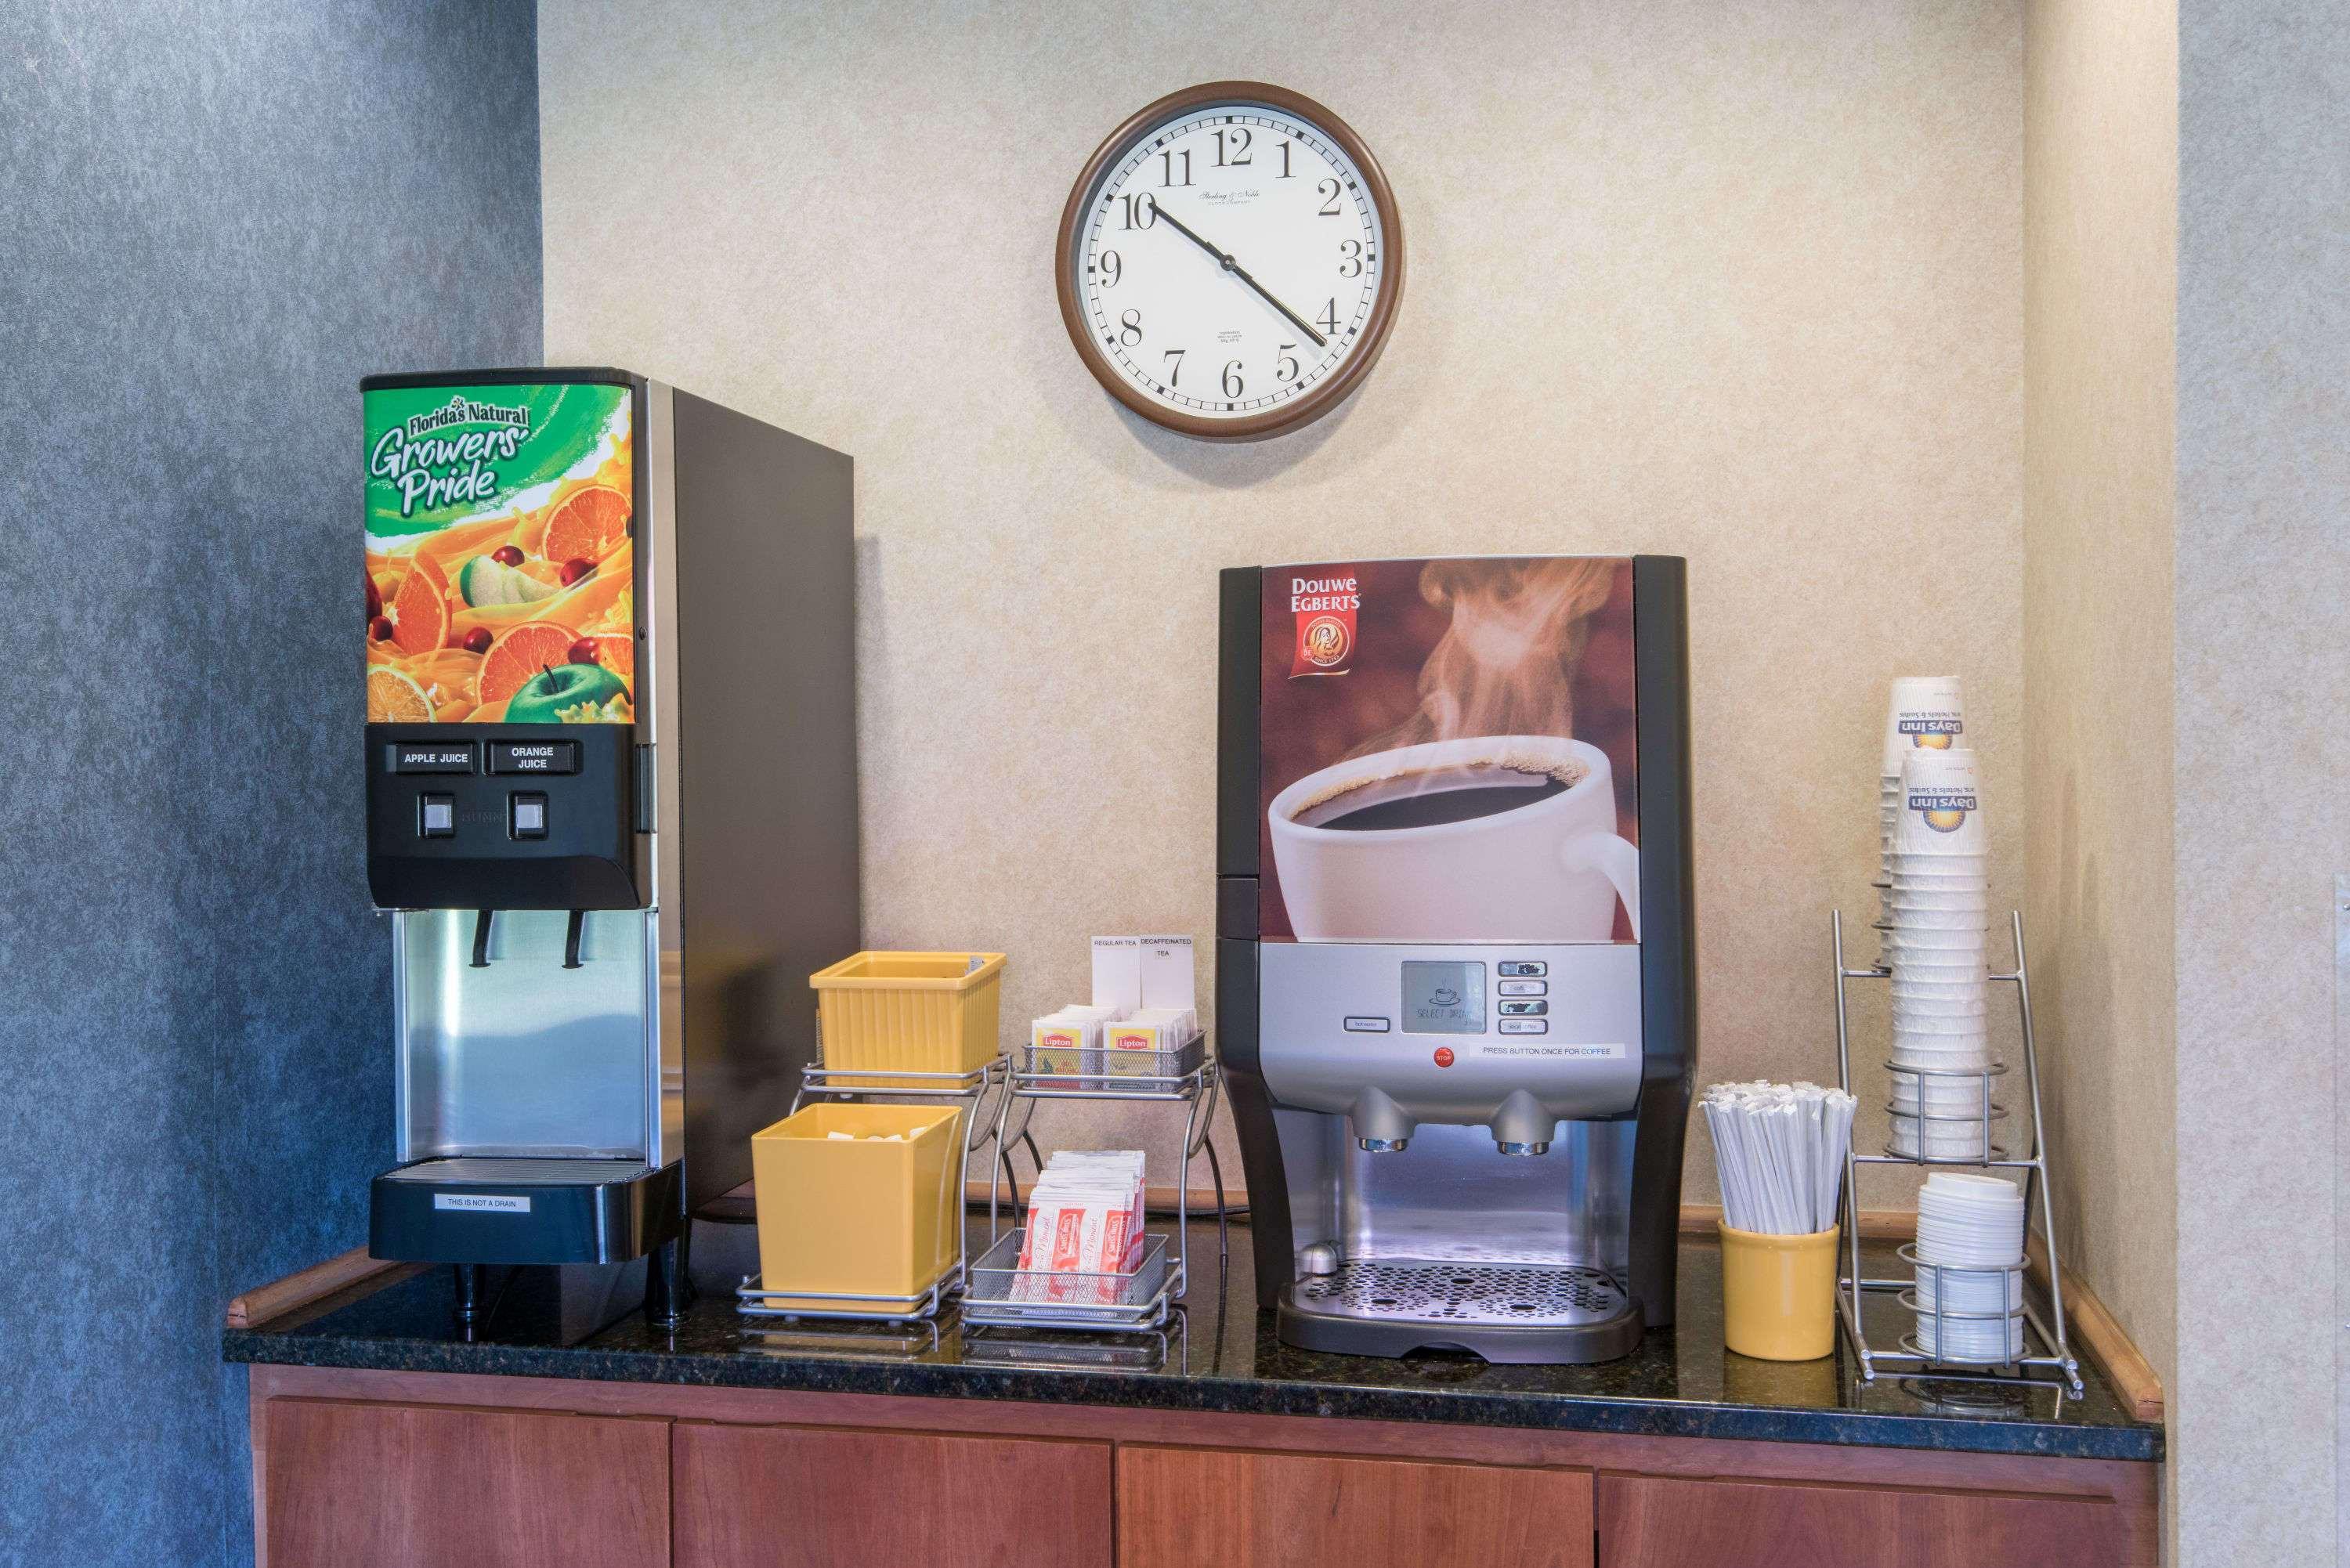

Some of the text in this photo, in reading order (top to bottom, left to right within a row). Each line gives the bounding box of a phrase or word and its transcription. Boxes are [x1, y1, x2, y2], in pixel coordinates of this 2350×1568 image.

[1211, 128, 1253, 167] 12
[1275, 140, 1296, 179] 1
[1158, 149, 1196, 187] 11
[1118, 192, 1157, 231] 10
[1318, 178, 1341, 216] 2
[1100, 250, 1121, 288] 9
[1340, 240, 1361, 278] 3
[1121, 309, 1142, 347] 8
[1316, 297, 1341, 335] 4
[1163, 349, 1186, 387] 7
[1222, 360, 1244, 398] 6
[1276, 344, 1299, 381] 5
[409, 403, 526, 435] Florida's Natural
[397, 461, 495, 515] Pride
[1292, 595, 1360, 612] EGBERTS
[1902, 721, 1961, 732] Days Inn
[404, 753, 468, 764] APPLE JUICE
[512, 746, 554, 757] ORANGE
[518, 758, 548, 769] JUICE
[1912, 797, 1974, 808] Days Inn
[1045, 1037, 1071, 1048] Lipton
[1119, 1039, 1146, 1050] Lipton
[1483, 1046, 1508, 1055] PRESS
